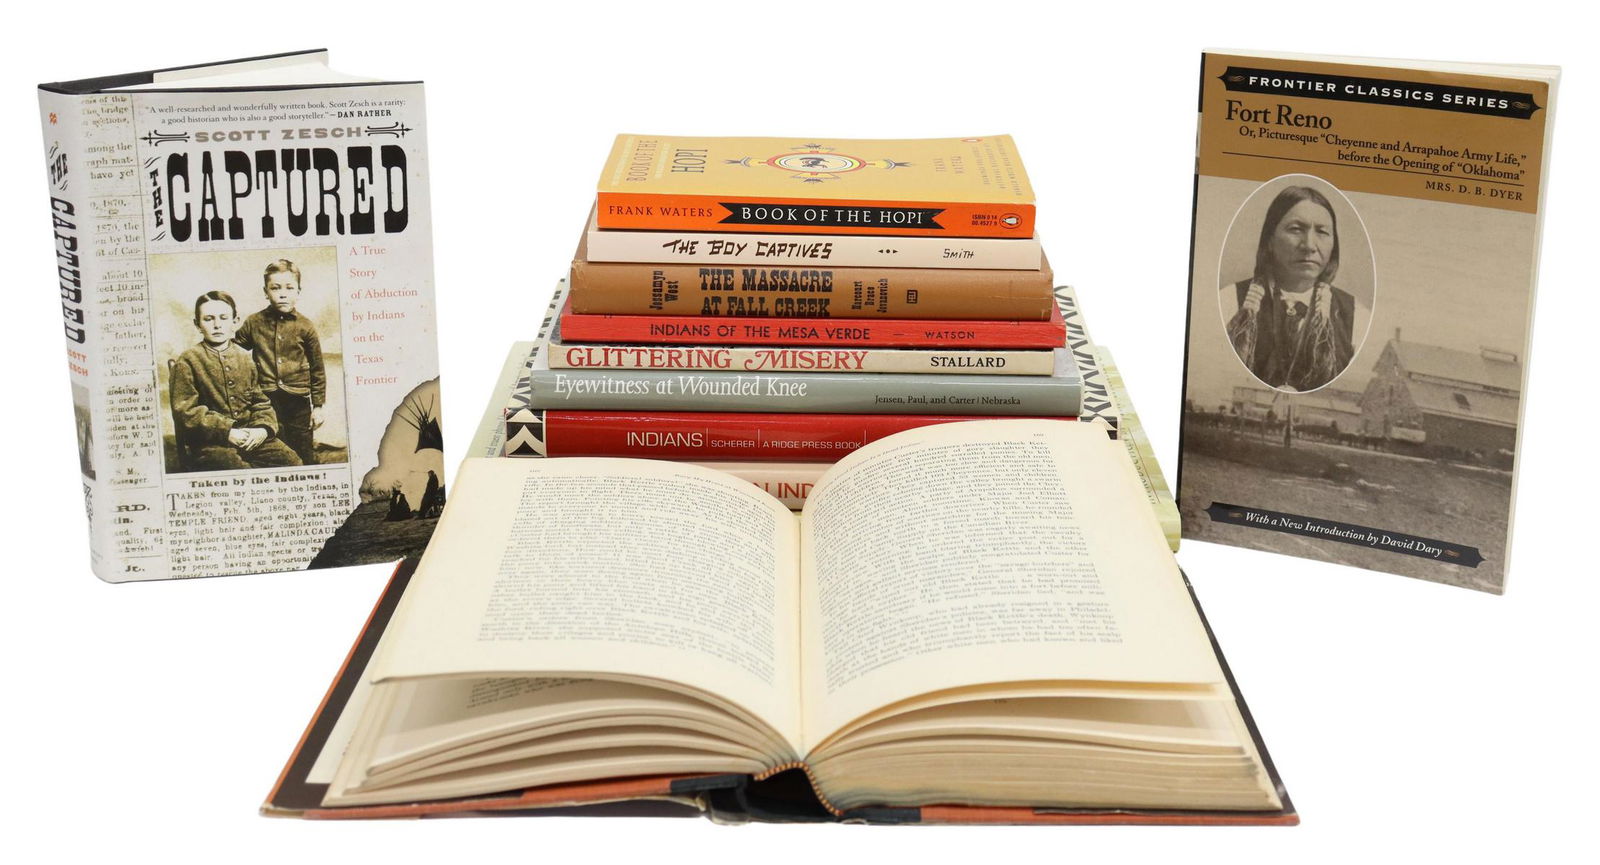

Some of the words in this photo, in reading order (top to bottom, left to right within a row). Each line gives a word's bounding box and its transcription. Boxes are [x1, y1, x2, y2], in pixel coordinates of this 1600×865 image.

[1249, 76, 1337, 93] FRONTIER
[1345, 84, 1434, 102] CLASSICS
[1442, 93, 1509, 110] SERIES
[158, 105, 215, 115] well-researched
[217, 104, 231, 112] and
[233, 102, 277, 113] wonderfully
[280, 102, 305, 110] written
[307, 101, 327, 110] book.
[329, 100, 347, 109] Scott
[349, 100, 369, 108] Zesch
[371, 99, 377, 107] is
[1225, 99, 1271, 122] Fort
[1276, 105, 1333, 131] Reno
[167, 116, 185, 126] good
[186, 115, 220, 123] historian
[222, 114, 237, 122] who
[247, 113, 261, 121] also
[268, 113, 287, 122] good
[337, 110, 355, 119] DAN
[358, 109, 392, 118] RATHER
[195, 129, 271, 143] SCOTT
[281, 126, 363, 141] ZESCH
[1239, 125, 1257, 139] Or,
[1258, 127, 1319, 146] Picturesque
[1320, 132, 1378, 151] “Cheyenne
[1380, 139, 1401, 152] and
[1402, 141, 1459, 160] Arrapahoe
[1461, 148, 1494, 164] Army
[1495, 152, 1527, 167] Life,”
[50, 153, 68, 185] THE
[671, 149, 708, 173] HOPI
[1337, 149, 1371, 164] before
[1373, 153, 1391, 165] the
[1392, 154, 1440, 174] Opening
[1442, 159, 1456, 173] of
[1457, 161, 1526, 181] “Oklahoma”
[149, 169, 164, 229] THE
[166, 144, 409, 243] CAPTURED
[1425, 180, 1455, 193] MRS.
[1458, 183, 1471, 194] D.
[1475, 185, 1487, 196] B.
[1489, 187, 1523, 201] DYER
[609, 205, 653, 216] FRANK
[660, 207, 713, 217] WATERS
[741, 207, 798, 221] BOOK
[804, 208, 829, 222] OF
[834, 209, 872, 223] THE
[879, 211, 923, 224] HOPI
[349, 247, 358, 256] A
[361, 245, 386, 255] True
[662, 239, 699, 255] THE
[707, 240, 747, 257] BOY
[756, 241, 833, 259] CAPTIVES
[50, 196, 86, 345] CAPTURED
[349, 268, 377, 279] Story
[649, 270, 666, 310] Jessamyn
[699, 268, 735, 291] THE
[741, 269, 833, 293] MASSACRE
[351, 289, 362, 299] of
[364, 288, 418, 299] Abduction
[664, 280, 679, 302] West
[352, 311, 364, 322] by
[367, 310, 406, 320] Indians
[700, 296, 722, 317] AT
[726, 296, 770, 317] FALL
[774, 297, 831, 318] CREEK
[353, 334, 366, 342] on
[368, 332, 385, 342] the
[650, 323, 710, 338] INDIANS
[717, 325, 737, 338] OF
[743, 325, 770, 338] THE
[778, 326, 819, 340] MESA
[825, 327, 871, 340] VERDE
[925, 330, 975, 340] WATSON
[354, 354, 384, 364] Texas
[566, 347, 732, 370] GLITTERING
[743, 349, 868, 371] MISERY
[930, 356, 1006, 369] STALLARD
[355, 375, 398, 386] Frontier
[554, 374, 650, 400] Eyewitness
[656, 378, 674, 395] at
[679, 376, 760, 396] Wounded
[766, 377, 808, 397] Knee
[874, 395, 905, 407] Jensen,
[907, 395, 928, 406] Paul,
[930, 396, 946, 405] and
[948, 396, 975, 405] Carter
[982, 396, 1021, 406] Nebraska
[627, 431, 703, 447] INDIANS
[711, 440, 755, 448] SCHERER
[762, 440, 770, 448] A
[771, 440, 800, 449] RIDGE
[802, 441, 832, 449] PRESS
[835, 441, 861, 450] BOOK
[190, 480, 228, 488] Taken
[233, 478, 246, 487] by
[251, 477, 270, 485] the
[234, 490, 246, 498] my
[278, 487, 288, 495] by
[306, 483, 338, 491] Indians,
[185, 501, 213, 509] Legion
[332, 499, 350, 507] LEE
[168, 518, 206, 527] TEMPLE
[277, 513, 298, 522] eight
[329, 509, 351, 517] black
[1245, 511, 1270, 526] With
[1271, 518, 1278, 526] a
[1279, 517, 1304, 530] New
[1304, 521, 1365, 541] Introduction
[1366, 531, 1379, 546] by
[1380, 534, 1414, 550] David
[1415, 541, 1443, 557] Dary
